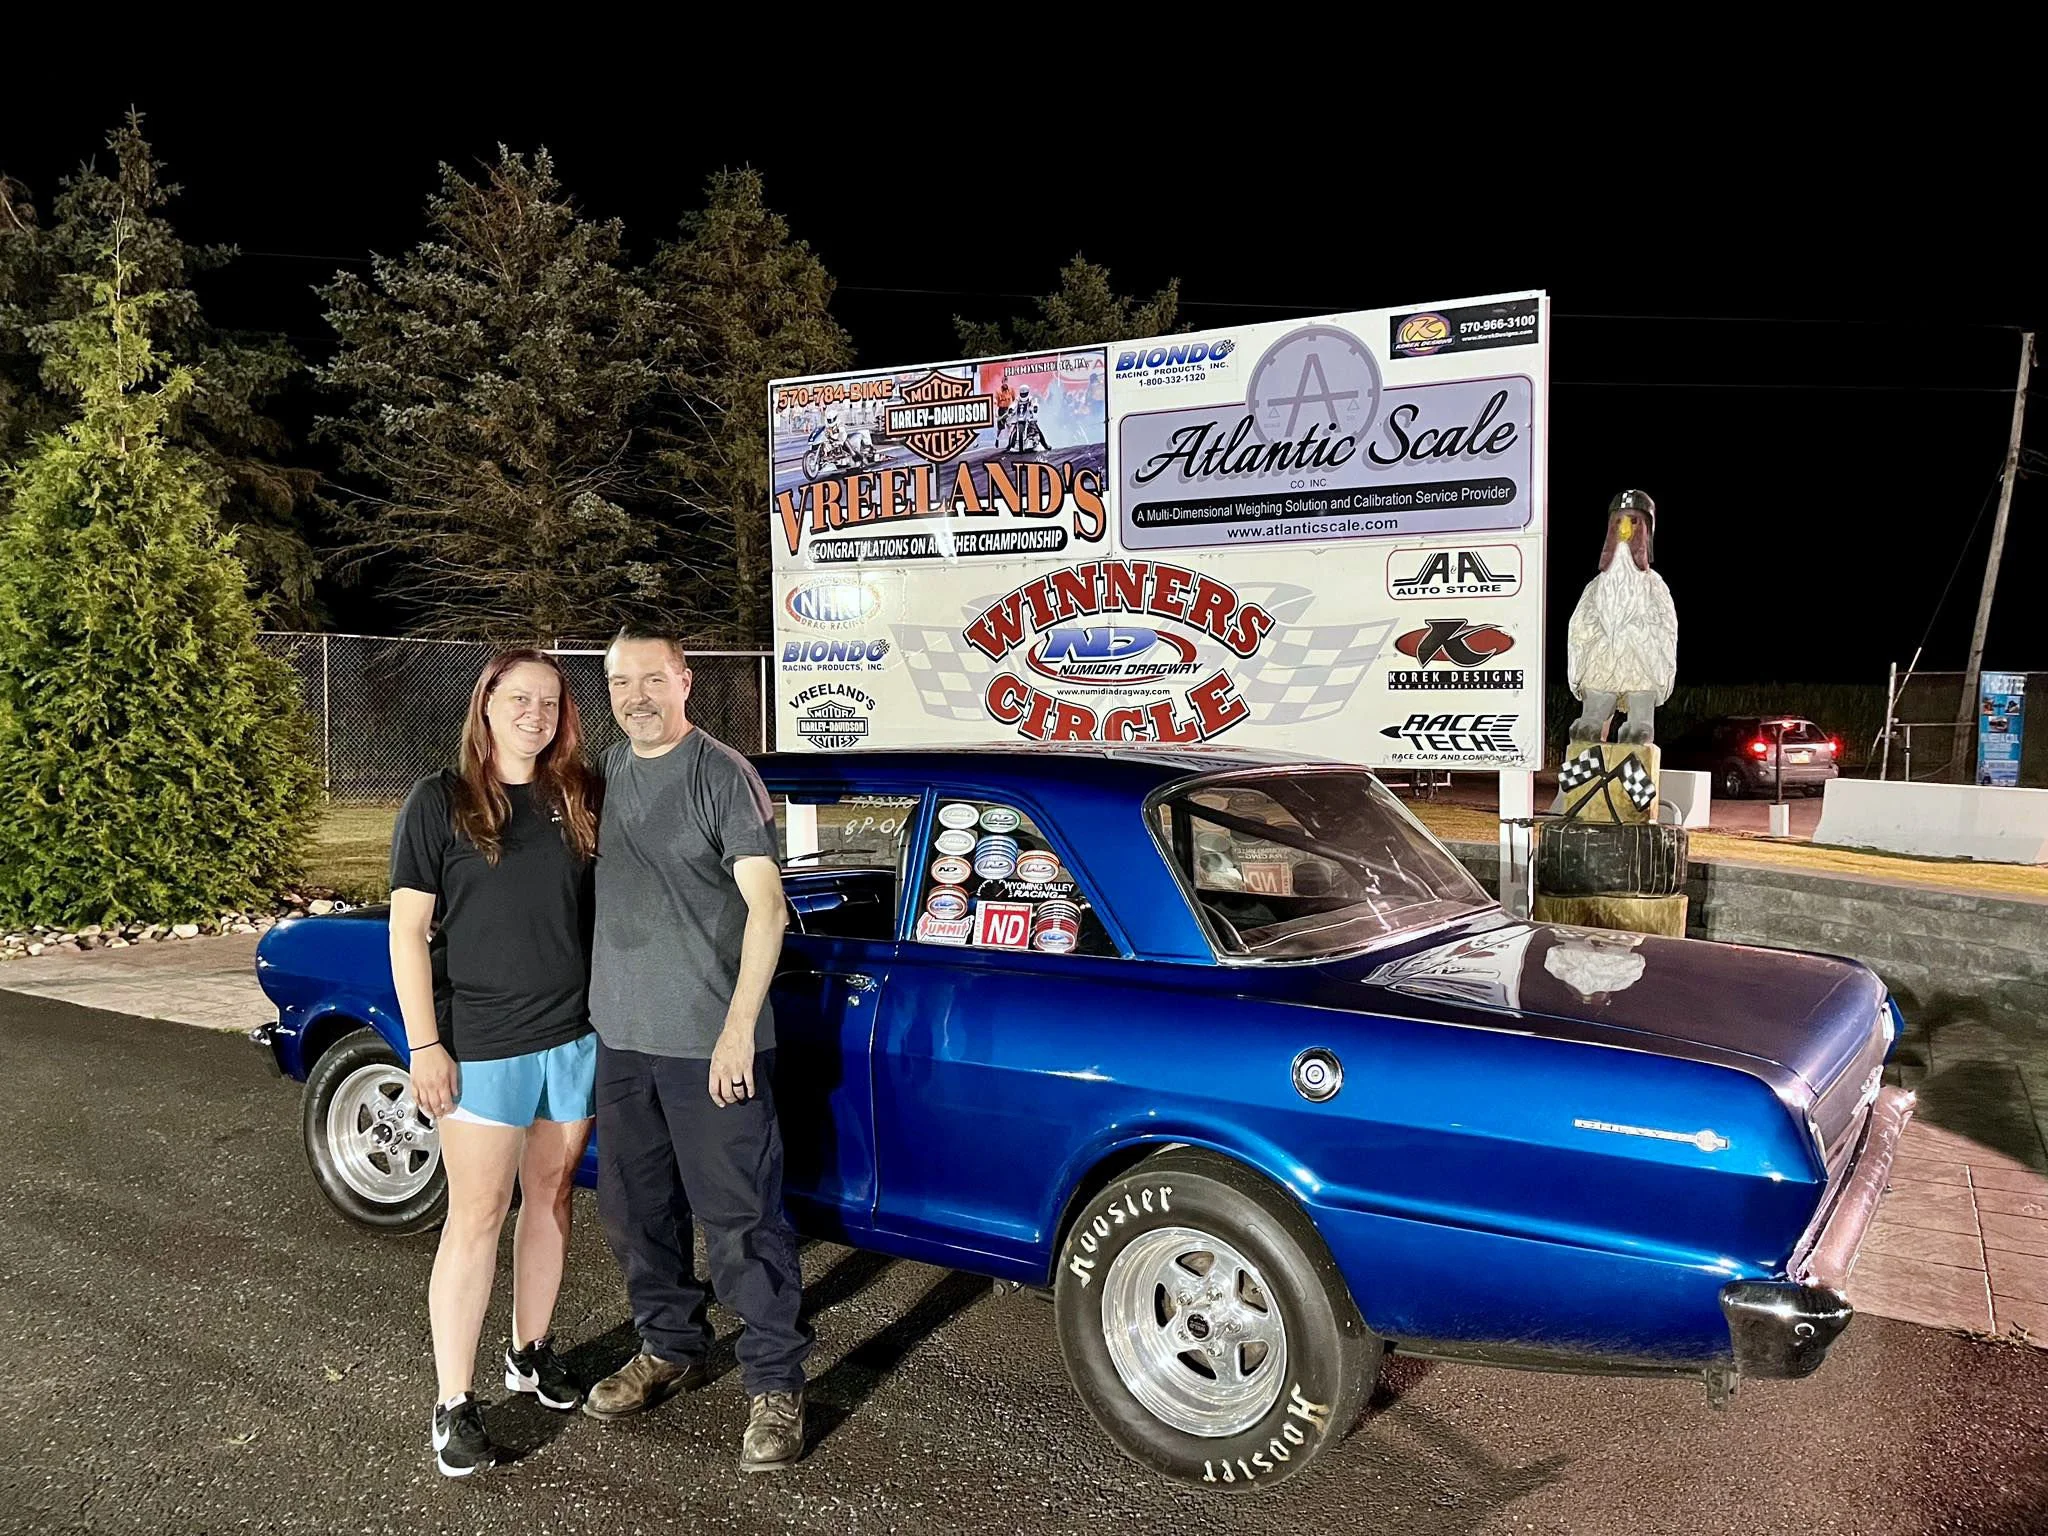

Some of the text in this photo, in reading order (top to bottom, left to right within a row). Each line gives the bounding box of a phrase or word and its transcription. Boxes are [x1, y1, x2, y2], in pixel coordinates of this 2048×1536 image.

[1460, 315, 1536, 333] 570-966-3100
[1115, 340, 1231, 371] BIONDO
[1115, 370, 1149, 379] RACING
[1154, 365, 1205, 376] PRODUCTS,
[1139, 373, 1206, 387] 1-800-332-1320
[777, 380, 893, 409] 570-784-BIKE
[911, 381, 966, 402] MOTOR
[891, 402, 987, 429] HARLEY-DAVIDSON
[914, 430, 966, 456] CYCLES
[1135, 389, 1520, 483] Atlantic Scale
[1290, 478, 1327, 489] CO INC
[776, 462, 1106, 556] VREELAND'S
[1136, 486, 1510, 522] A Multi-Dimensional Weighing Solution and Calibration Service Provider
[1227, 520, 1398, 538] www.atlanticscale.com
[813, 531, 1062, 560] CONGRATULATIONS ON AHER CHAMPIONSHIP
[1396, 584, 1502, 595] AUTO STORE
[963, 560, 1276, 662] WINNERS
[801, 618, 826, 630] DRAG
[782, 640, 886, 662] BIONDO
[1039, 627, 1159, 662] ND
[817, 663, 863, 672] PRODUCTS,
[1058, 663, 1203, 675] NUMIDIA DRAGWAY
[1389, 671, 1523, 682] KOREK DESIGNS
[789, 683, 876, 711] VREELAND'S
[1057, 688, 1171, 697] www.numidiadragway.com
[814, 706, 849, 718] MOTOR
[985, 669, 1250, 742] CIRCLE
[800, 721, 865, 732] HARLEY-DAVIDSON
[1402, 714, 1497, 731] RACE
[1402, 734, 1498, 751] TECH
[1391, 753, 1414, 761] RACE
[1005, 881, 1074, 892] WYOMING VALLEY
[920, 915, 968, 938] SUMMIT
[986, 913, 1025, 945] ND
[1203, 1383, 1330, 1483] Hoosier
